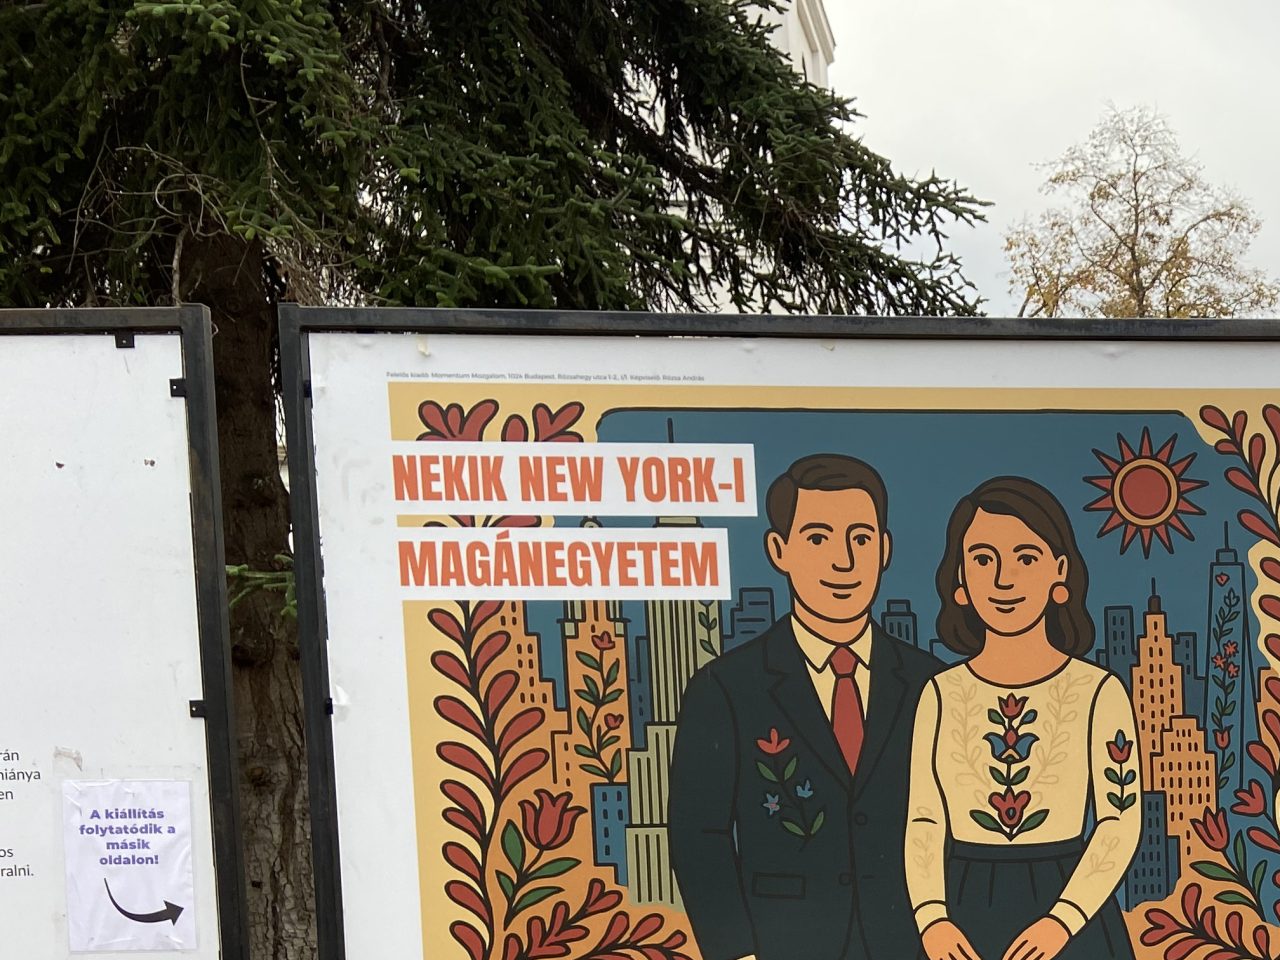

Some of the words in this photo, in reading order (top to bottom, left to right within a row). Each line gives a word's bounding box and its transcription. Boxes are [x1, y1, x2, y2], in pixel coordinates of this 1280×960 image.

[392, 454, 508, 501] NEKIK
[518, 455, 604, 502] NEW
[617, 456, 745, 503] YORK-I
[398, 529, 720, 588] MAGÁNEGYETEM
[89, 809, 101, 820] A
[105, 808, 165, 820] kiállítás
[79, 823, 163, 837] folytatódik
[167, 826, 176, 834] a
[106, 838, 151, 850] másik
[99, 855, 159, 866] oldalon!
